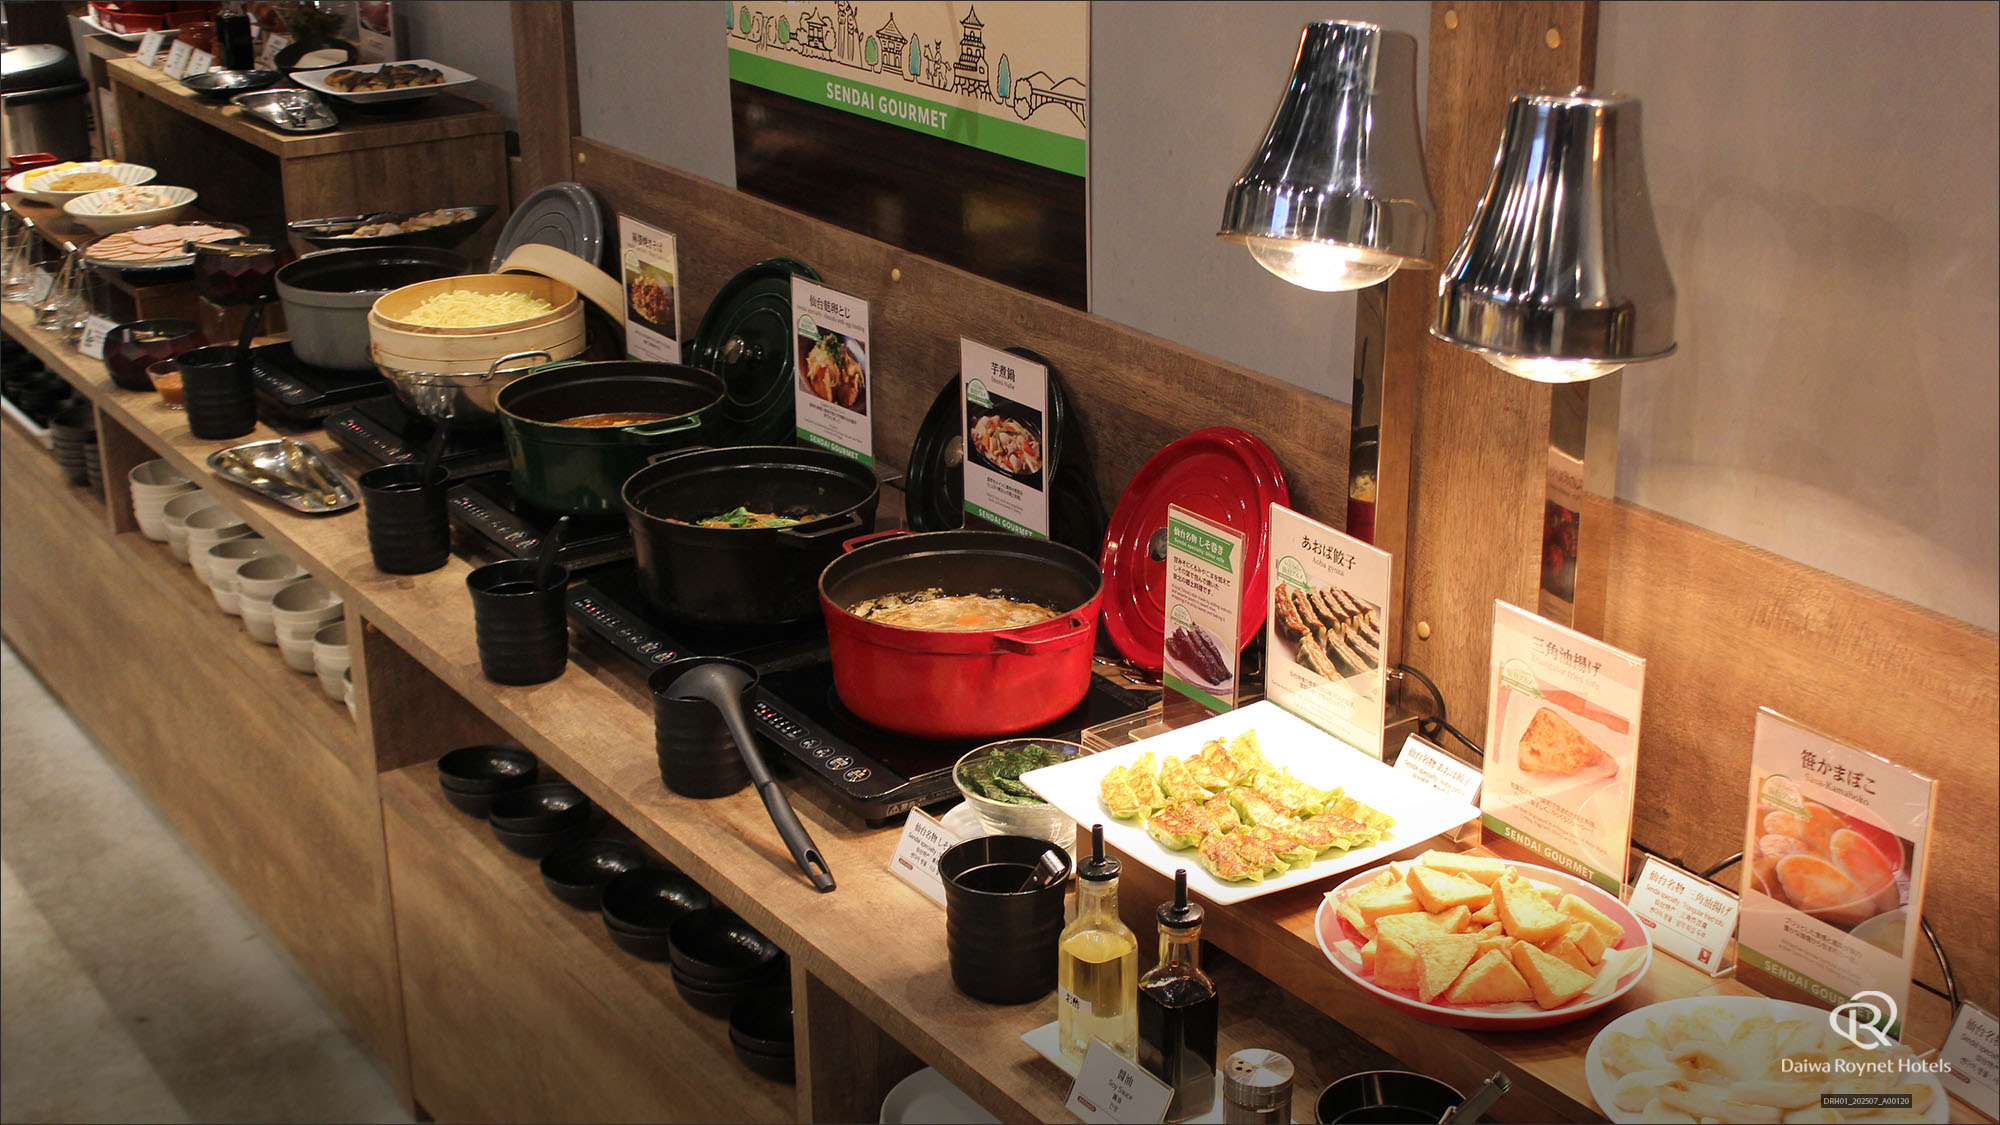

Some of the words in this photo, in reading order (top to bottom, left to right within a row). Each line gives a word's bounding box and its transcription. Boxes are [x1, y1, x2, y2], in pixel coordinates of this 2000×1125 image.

[826, 81, 874, 110] SENDAI
[878, 94, 948, 130] GOURMET
[992, 362, 1015, 382] 芋煮鍋
[810, 434, 830, 448] SENDAI
[831, 443, 858, 459] GOURMET
[978, 508, 1000, 524] SENDAI
[1002, 520, 1032, 536] GOURMET
[1174, 526, 1198, 543] 仙台名物
[1199, 537, 1224, 556] しそ巻き
[1302, 535, 1356, 570] あおば餃子
[1531, 636, 1602, 678] 三角油揚げ
[1800, 750, 1876, 795] 笹かまぼこ
[915, 822, 938, 844] 仙台名物
[1504, 827, 1542, 852] SENDAI
[1544, 848, 1594, 880] GOURMET
[1648, 870, 1685, 894] 仙台名物
[1686, 889, 1732, 916] 三角油揚げ
[1764, 960, 1808, 989] SENDAI
[1108, 1079, 1118, 1091] Soy
